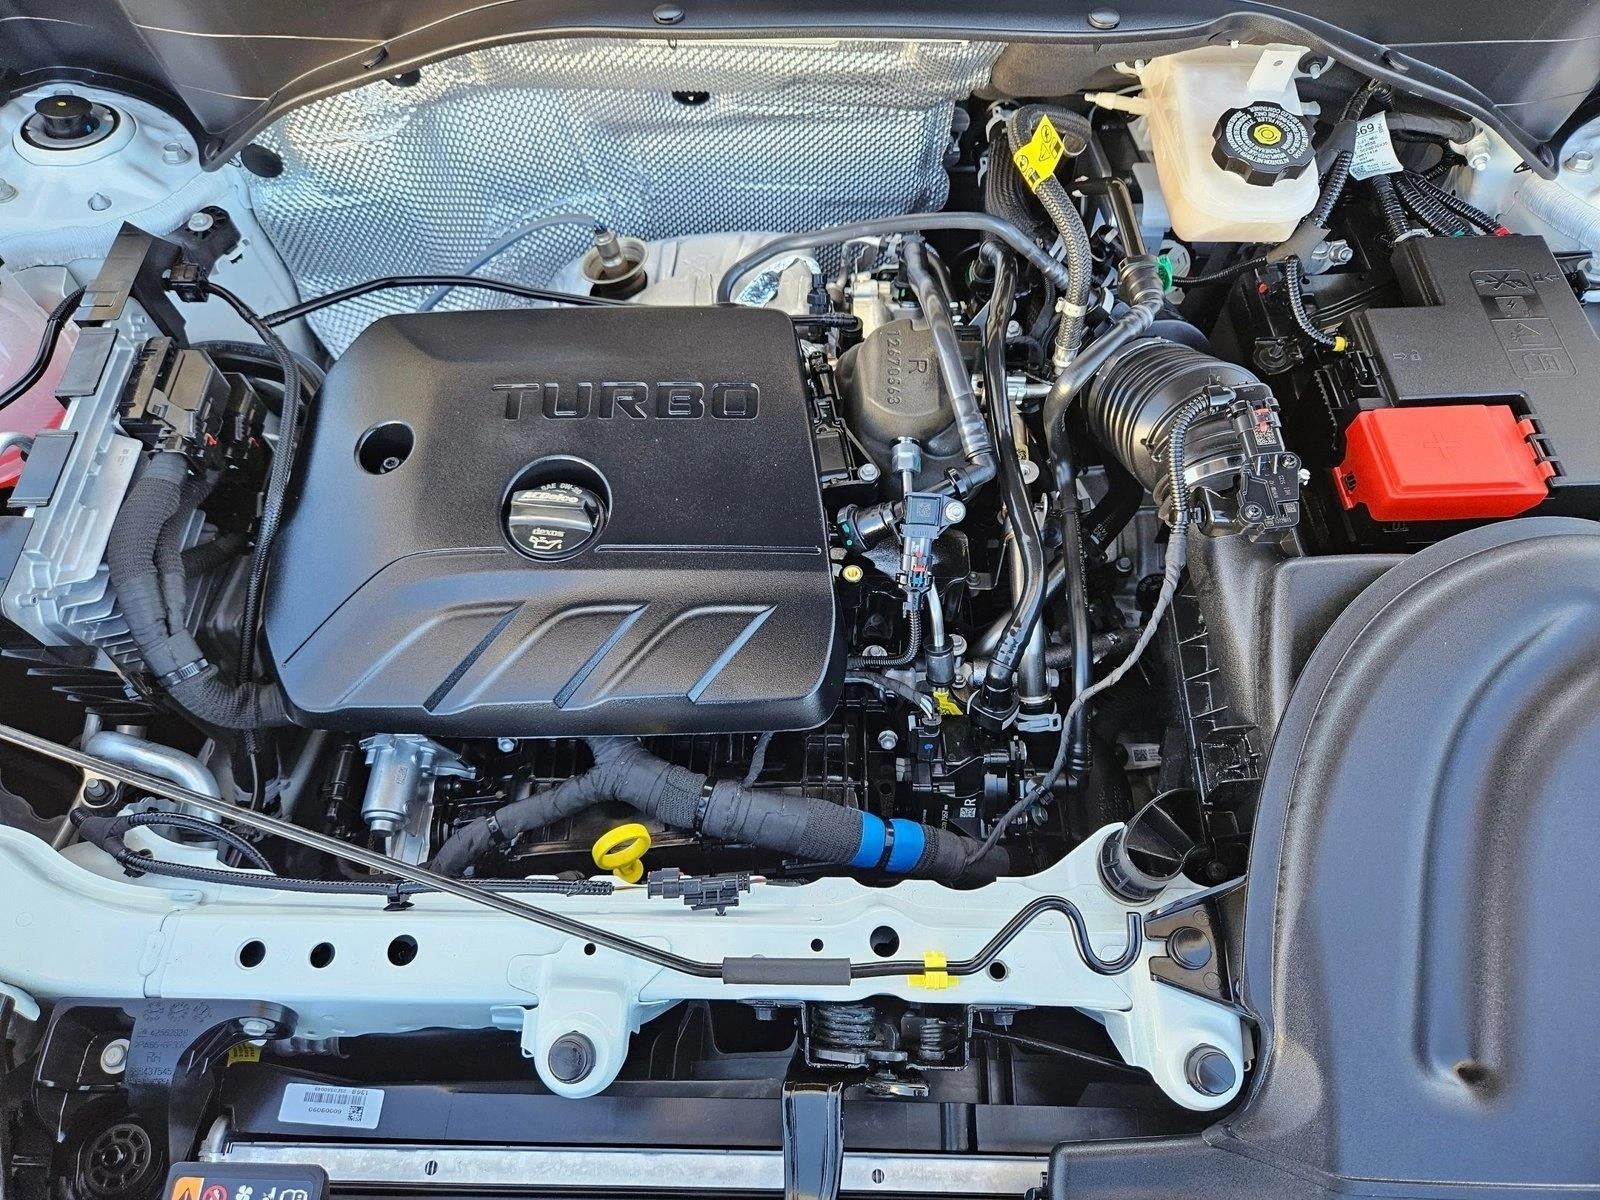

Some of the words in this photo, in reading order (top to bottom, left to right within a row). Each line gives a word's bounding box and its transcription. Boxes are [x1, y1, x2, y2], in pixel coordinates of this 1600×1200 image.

[908, 359, 928, 374] R
[491, 382, 760, 420] TURBO
[541, 483, 557, 491] SAE
[963, 798, 977, 806] R
